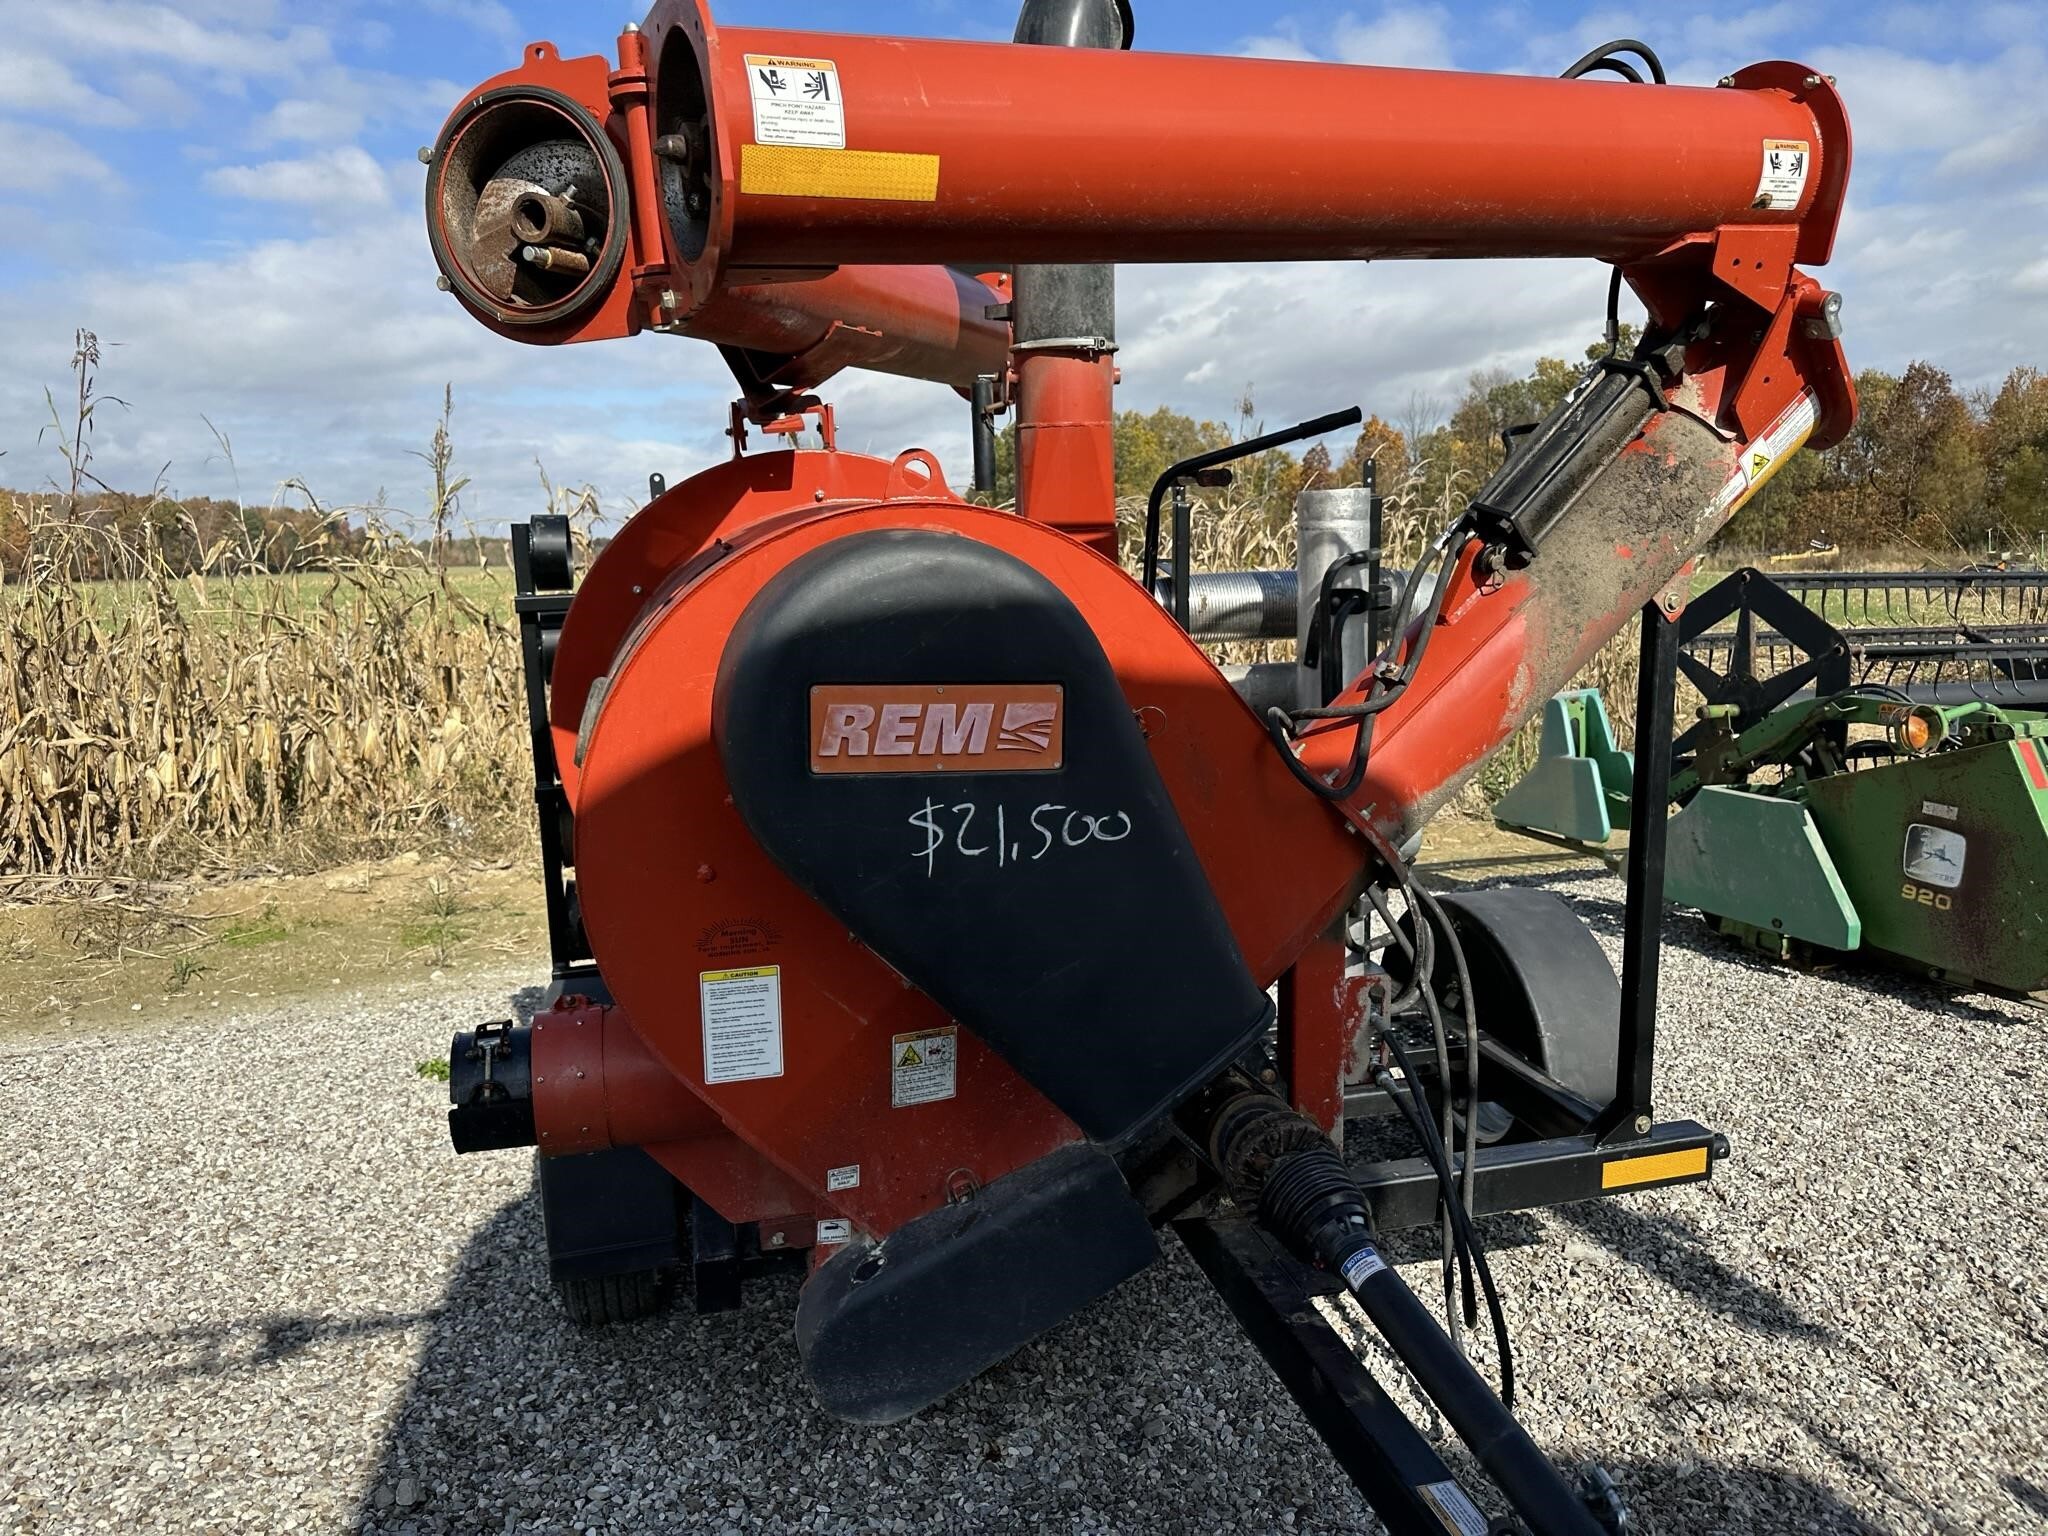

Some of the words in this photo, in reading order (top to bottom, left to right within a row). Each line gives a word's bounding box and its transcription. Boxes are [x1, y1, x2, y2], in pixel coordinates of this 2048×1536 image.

[776, 60, 816, 68] WARNING
[818, 703, 994, 756] REM
[908, 797, 1132, 878] $21,500
[1901, 883, 1953, 911] 920
[721, 929, 757, 937] Morning
[730, 936, 749, 944] SUN
[1346, 1251, 1367, 1269] NOTICE
